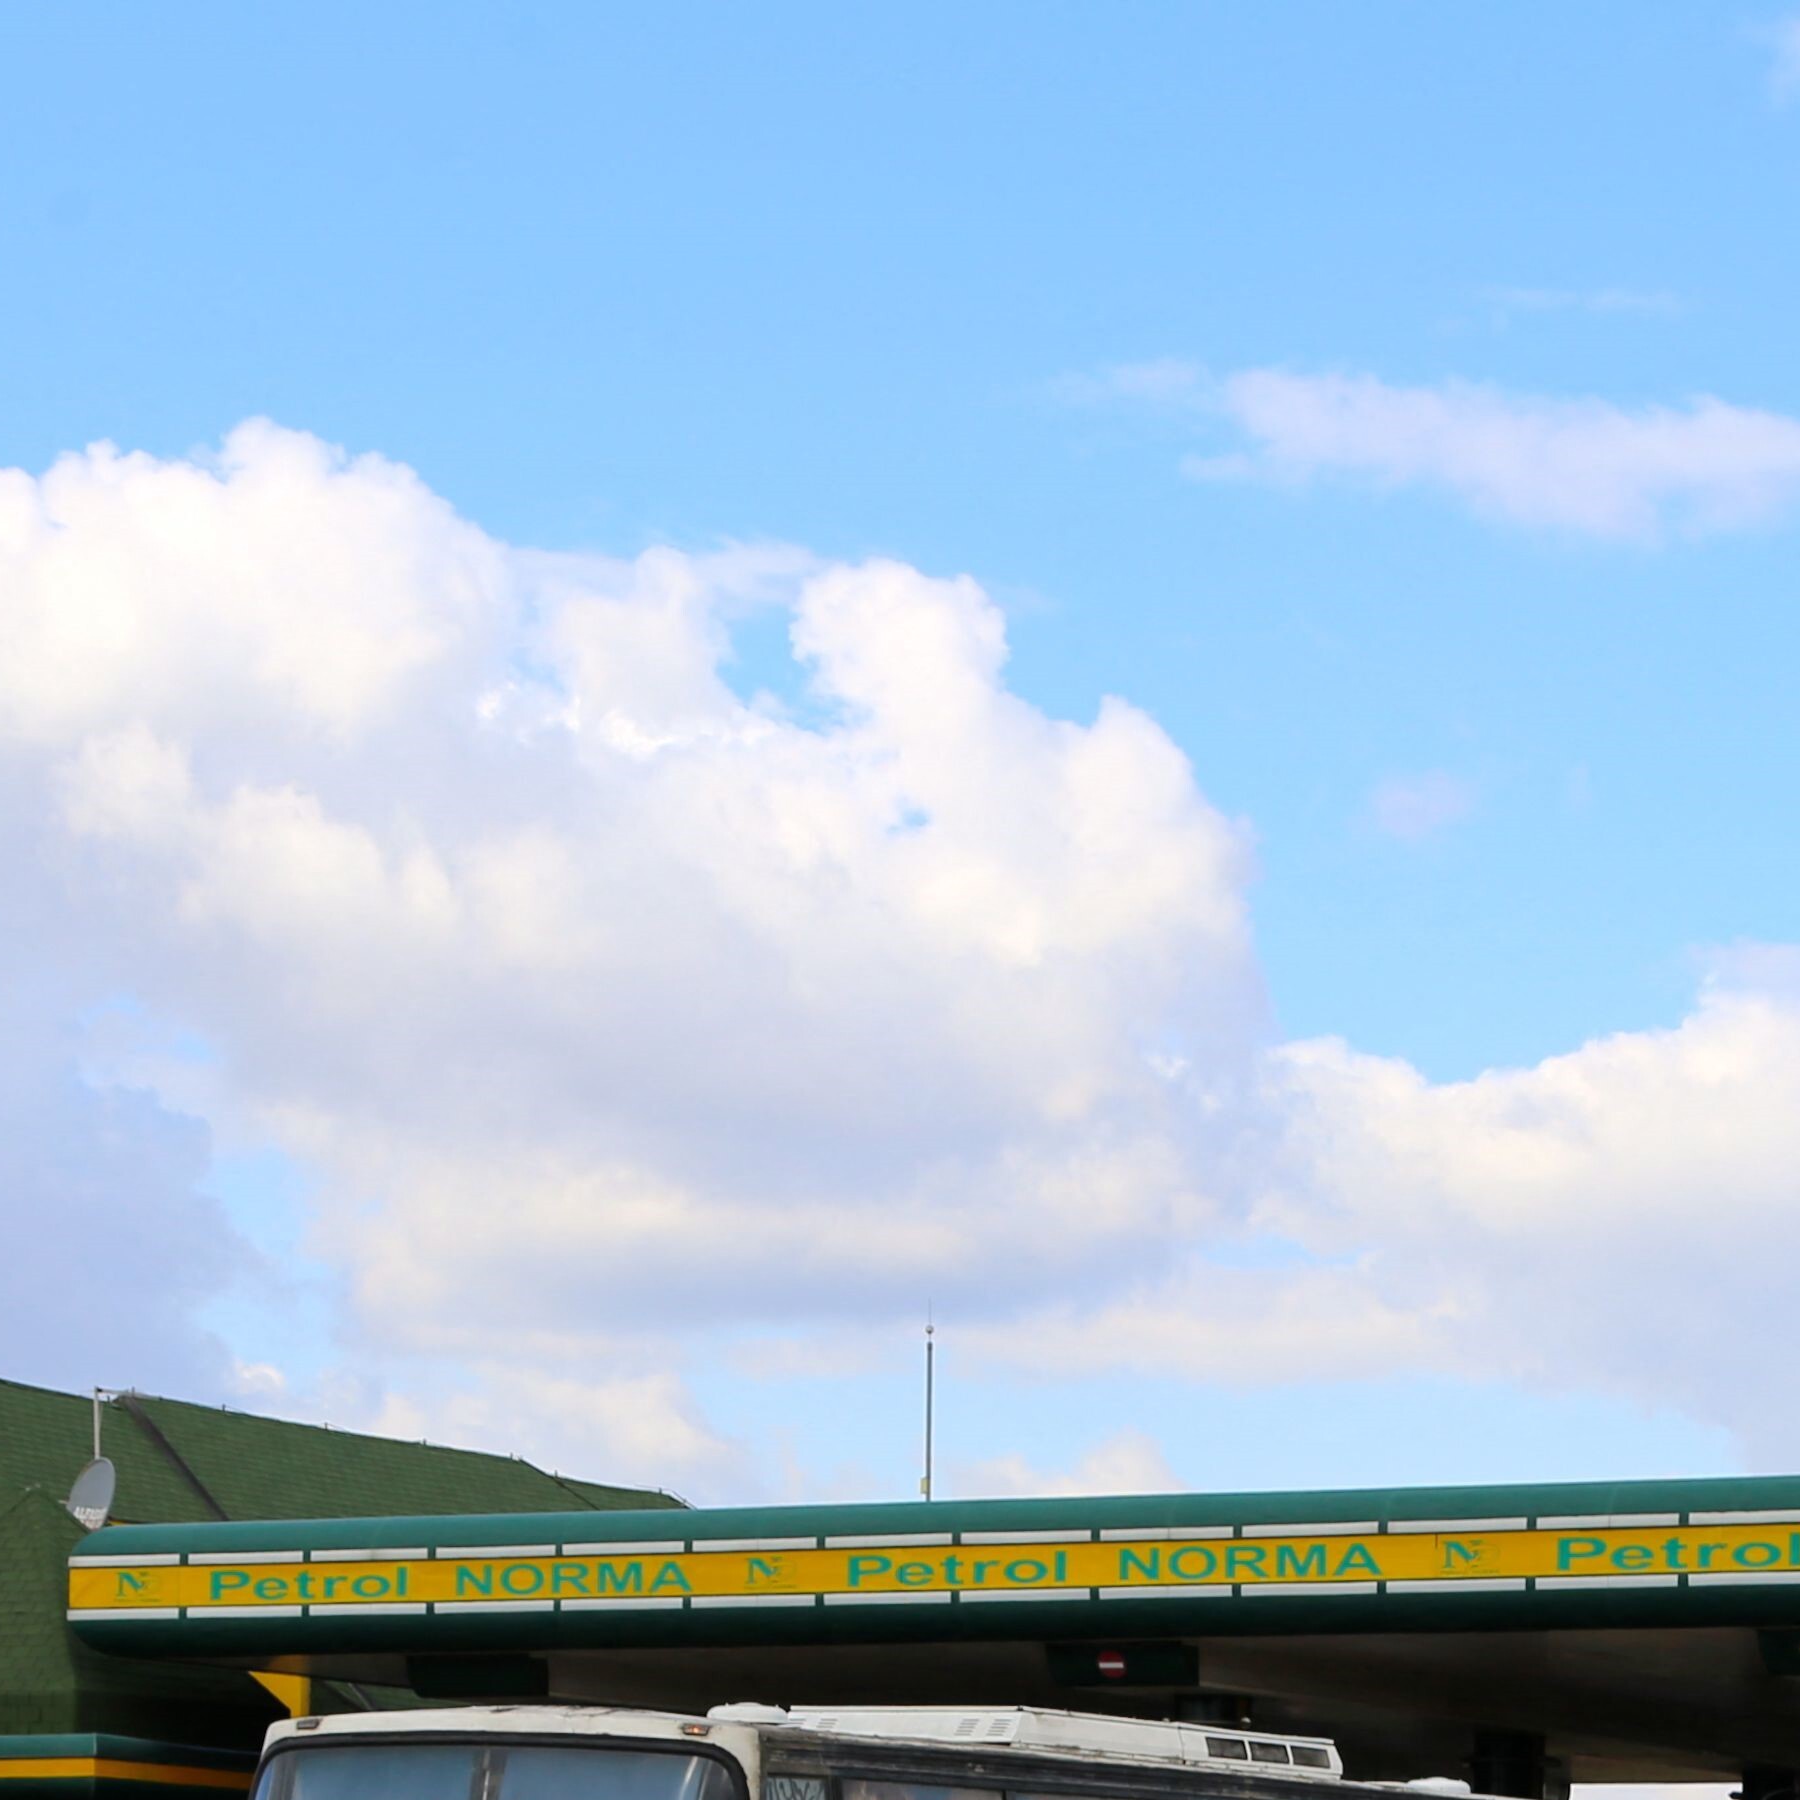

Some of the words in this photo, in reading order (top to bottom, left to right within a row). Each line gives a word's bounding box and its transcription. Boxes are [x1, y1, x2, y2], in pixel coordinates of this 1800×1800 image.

[210, 1566, 408, 1600] Petrol
[455, 1561, 692, 1597] NORMA
[847, 1550, 1067, 1588] Petrol
[1118, 1543, 1382, 1580] NORMA
